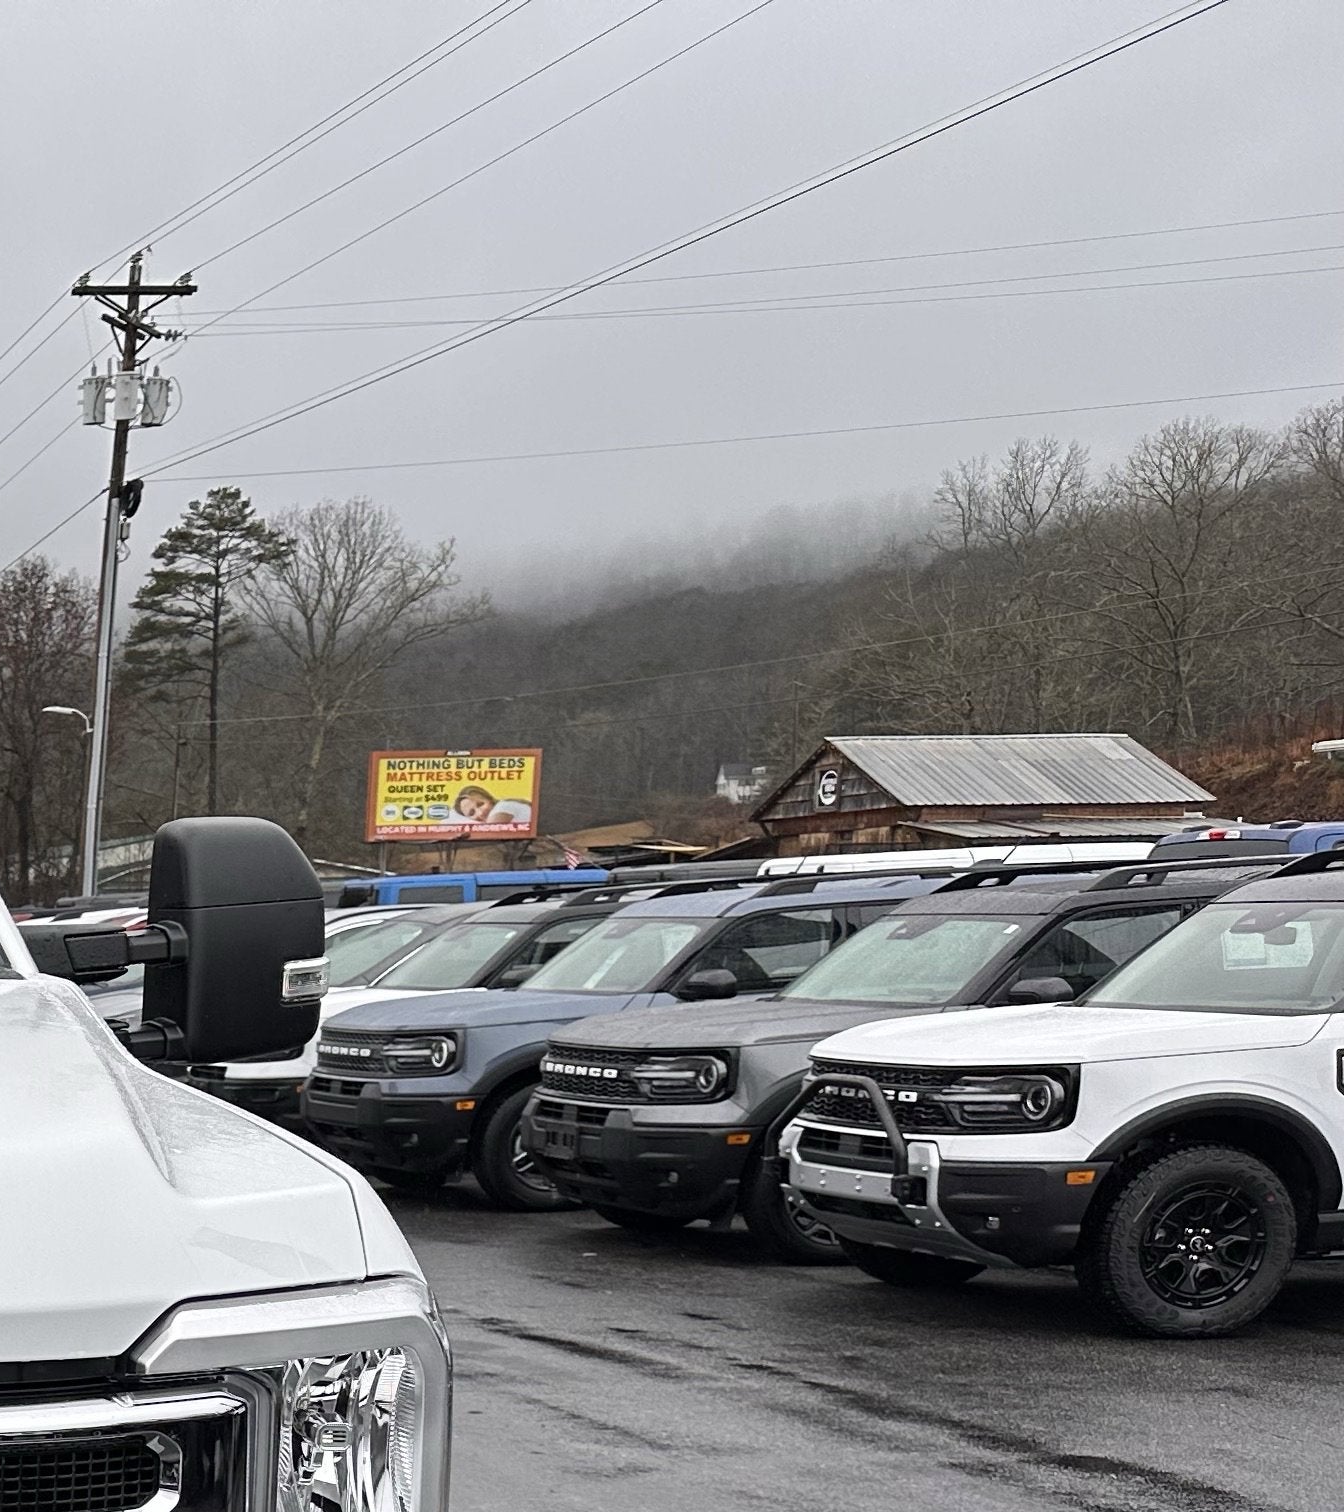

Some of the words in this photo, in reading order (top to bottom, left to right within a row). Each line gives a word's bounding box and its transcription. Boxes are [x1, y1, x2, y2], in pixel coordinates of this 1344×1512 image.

[386, 759, 451, 771] NOTHING
[456, 758, 484, 769] BUT
[488, 757, 525, 769] BEDS
[386, 770, 463, 782] MATTRESS
[467, 769, 524, 781] OUTLET
[387, 784, 424, 793] QUEEN
[426, 784, 446, 793] SET
[376, 825, 417, 834] LOCATED
[319, 1045, 371, 1057] BRONCO
[545, 1062, 618, 1078] BRONCO
